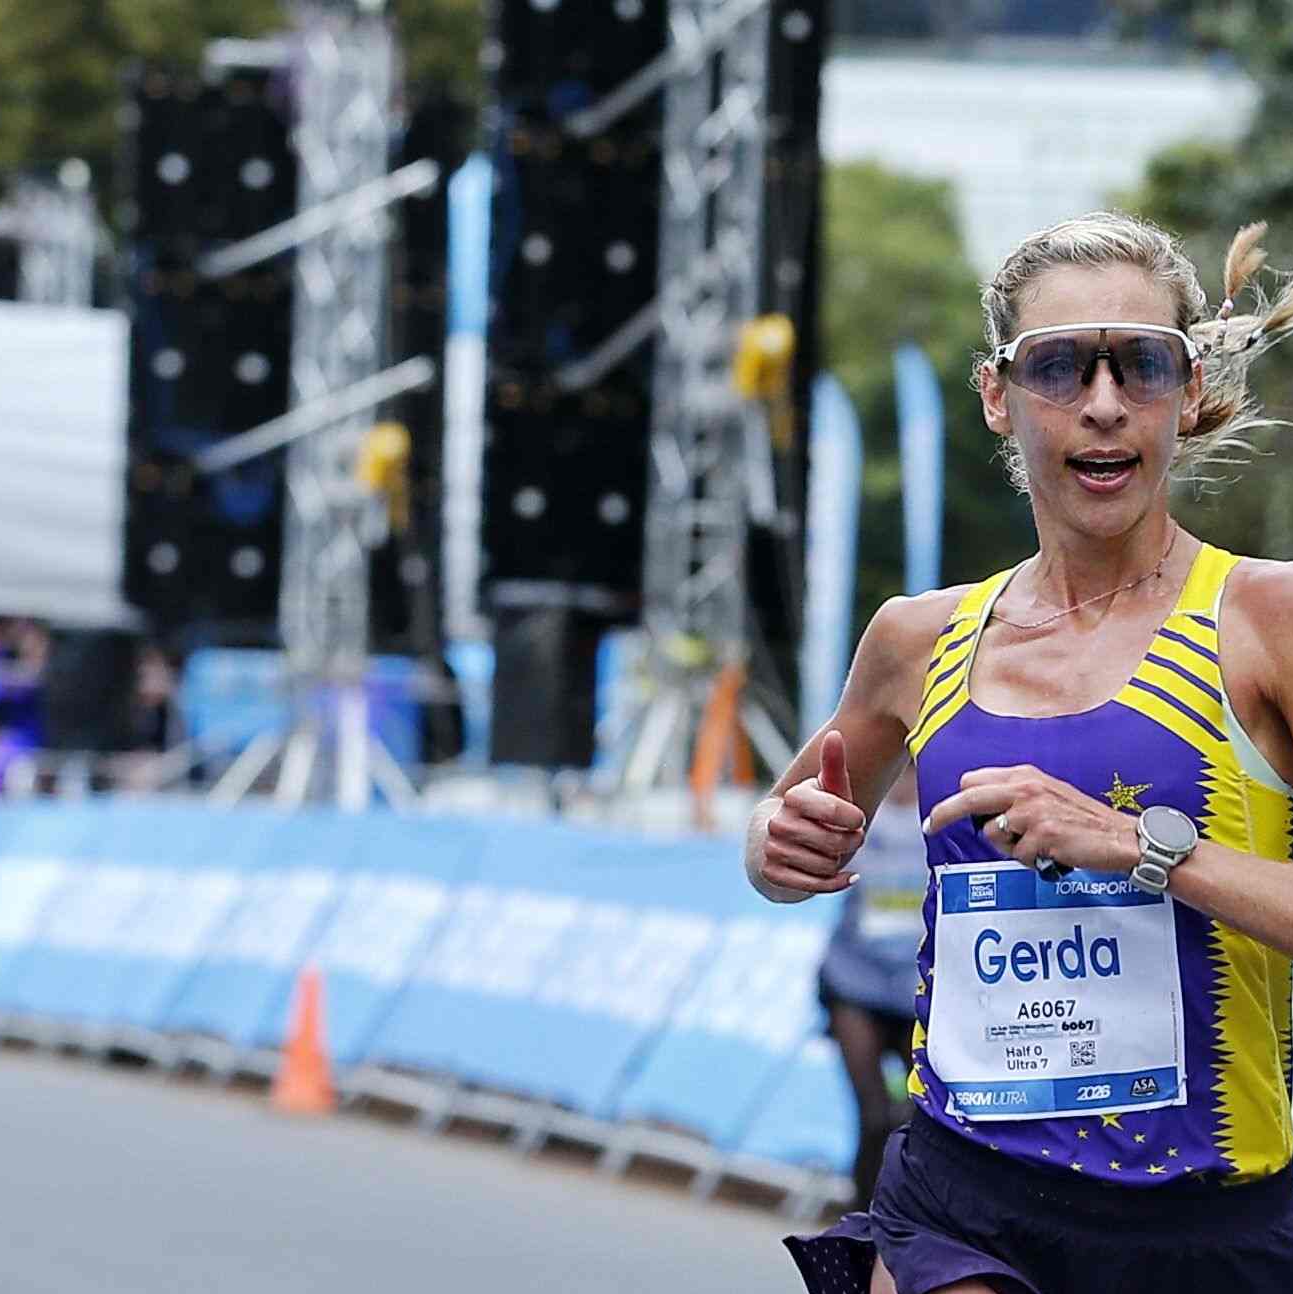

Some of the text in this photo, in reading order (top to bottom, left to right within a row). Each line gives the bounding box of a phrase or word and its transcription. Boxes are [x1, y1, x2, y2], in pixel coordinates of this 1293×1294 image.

[974, 924, 1121, 984] Gerda
[1017, 1000, 1076, 1020] A6067
[1061, 1020, 1094, 1032] 6067
[1006, 1045, 1030, 1058] Half
[1007, 1058, 1049, 1071] Ultra 7
[1132, 1077, 1156, 1090] ASA
